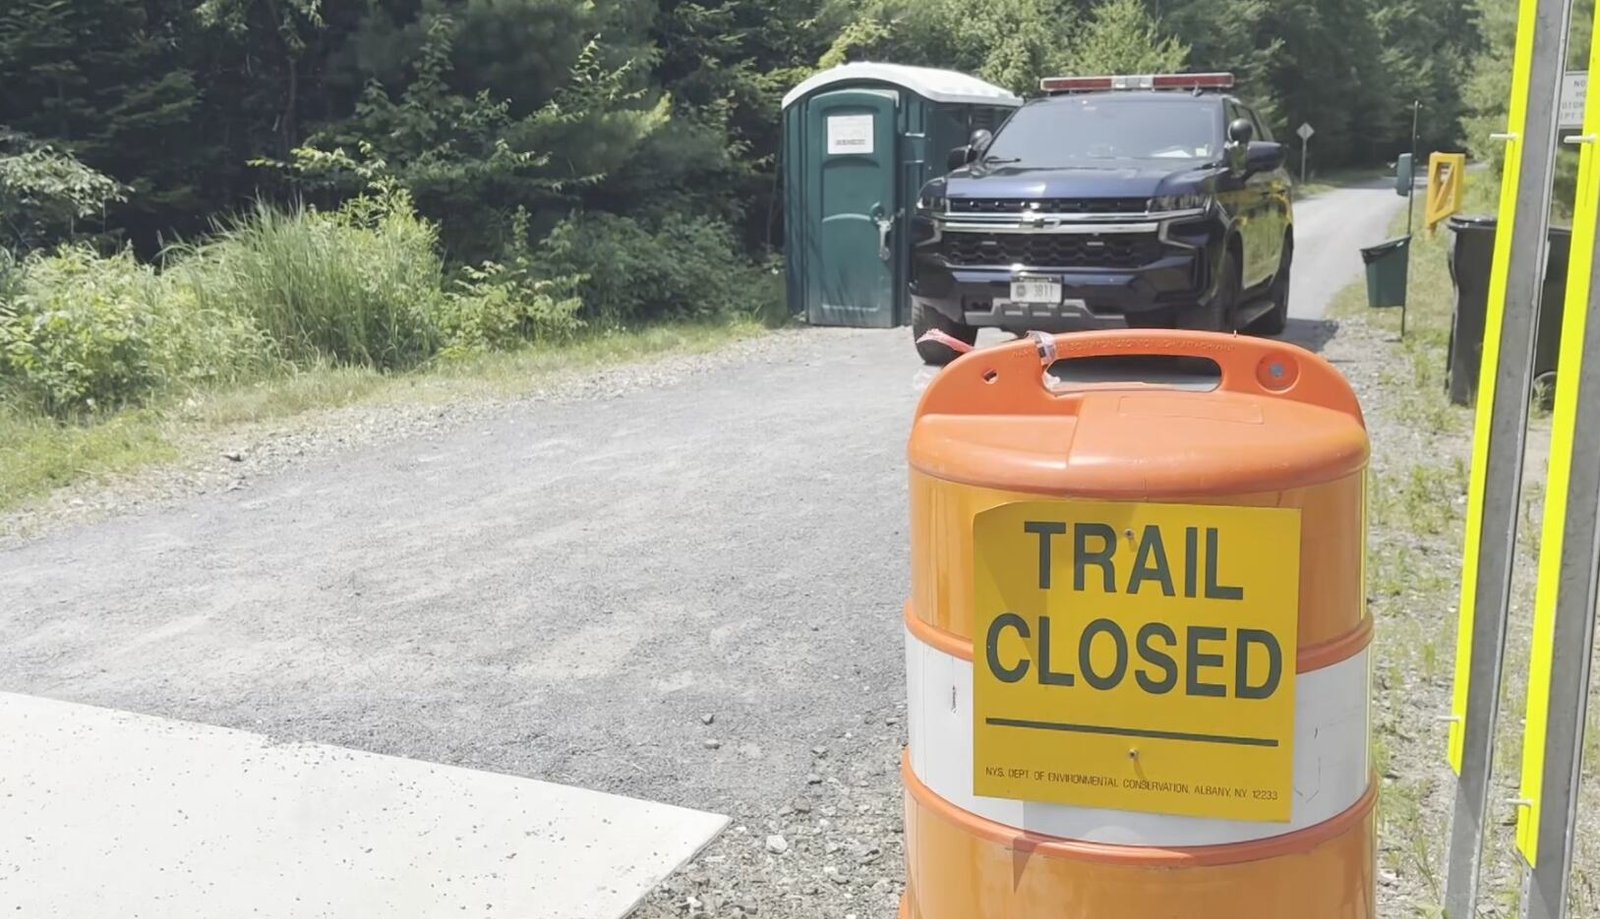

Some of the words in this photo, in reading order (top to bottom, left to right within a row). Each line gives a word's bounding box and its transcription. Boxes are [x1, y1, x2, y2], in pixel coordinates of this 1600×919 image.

[1024, 521, 1243, 600] TRAIL
[986, 613, 1282, 700] CLOSED
[1034, 770, 1045, 781] OF
[1048, 772, 1119, 788] ENVIRONMENTAL
[1252, 790, 1278, 800] 12233
